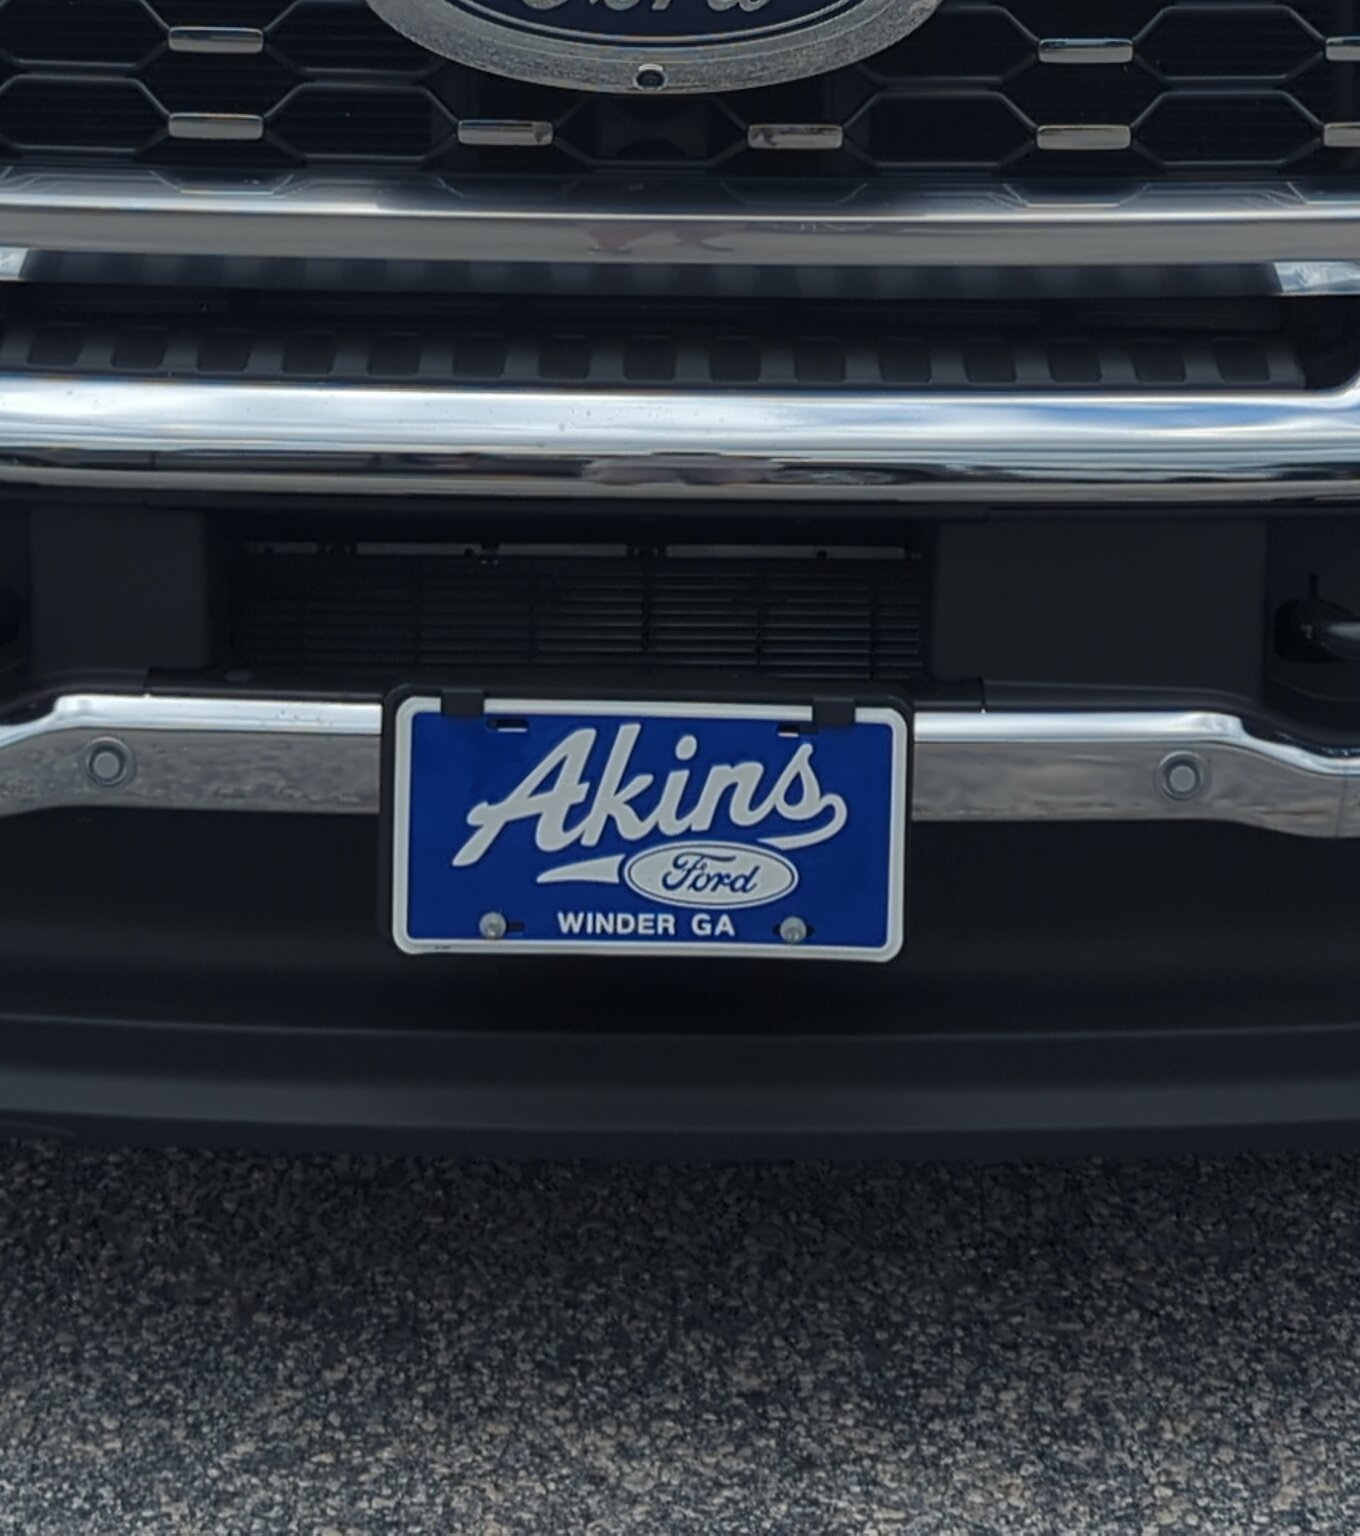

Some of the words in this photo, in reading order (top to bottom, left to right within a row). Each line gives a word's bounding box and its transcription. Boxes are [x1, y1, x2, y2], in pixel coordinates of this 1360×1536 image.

[451, 723, 848, 867] Akins
[660, 851, 759, 896] Ford
[557, 911, 677, 937] WINDER
[691, 913, 736, 938] GA
